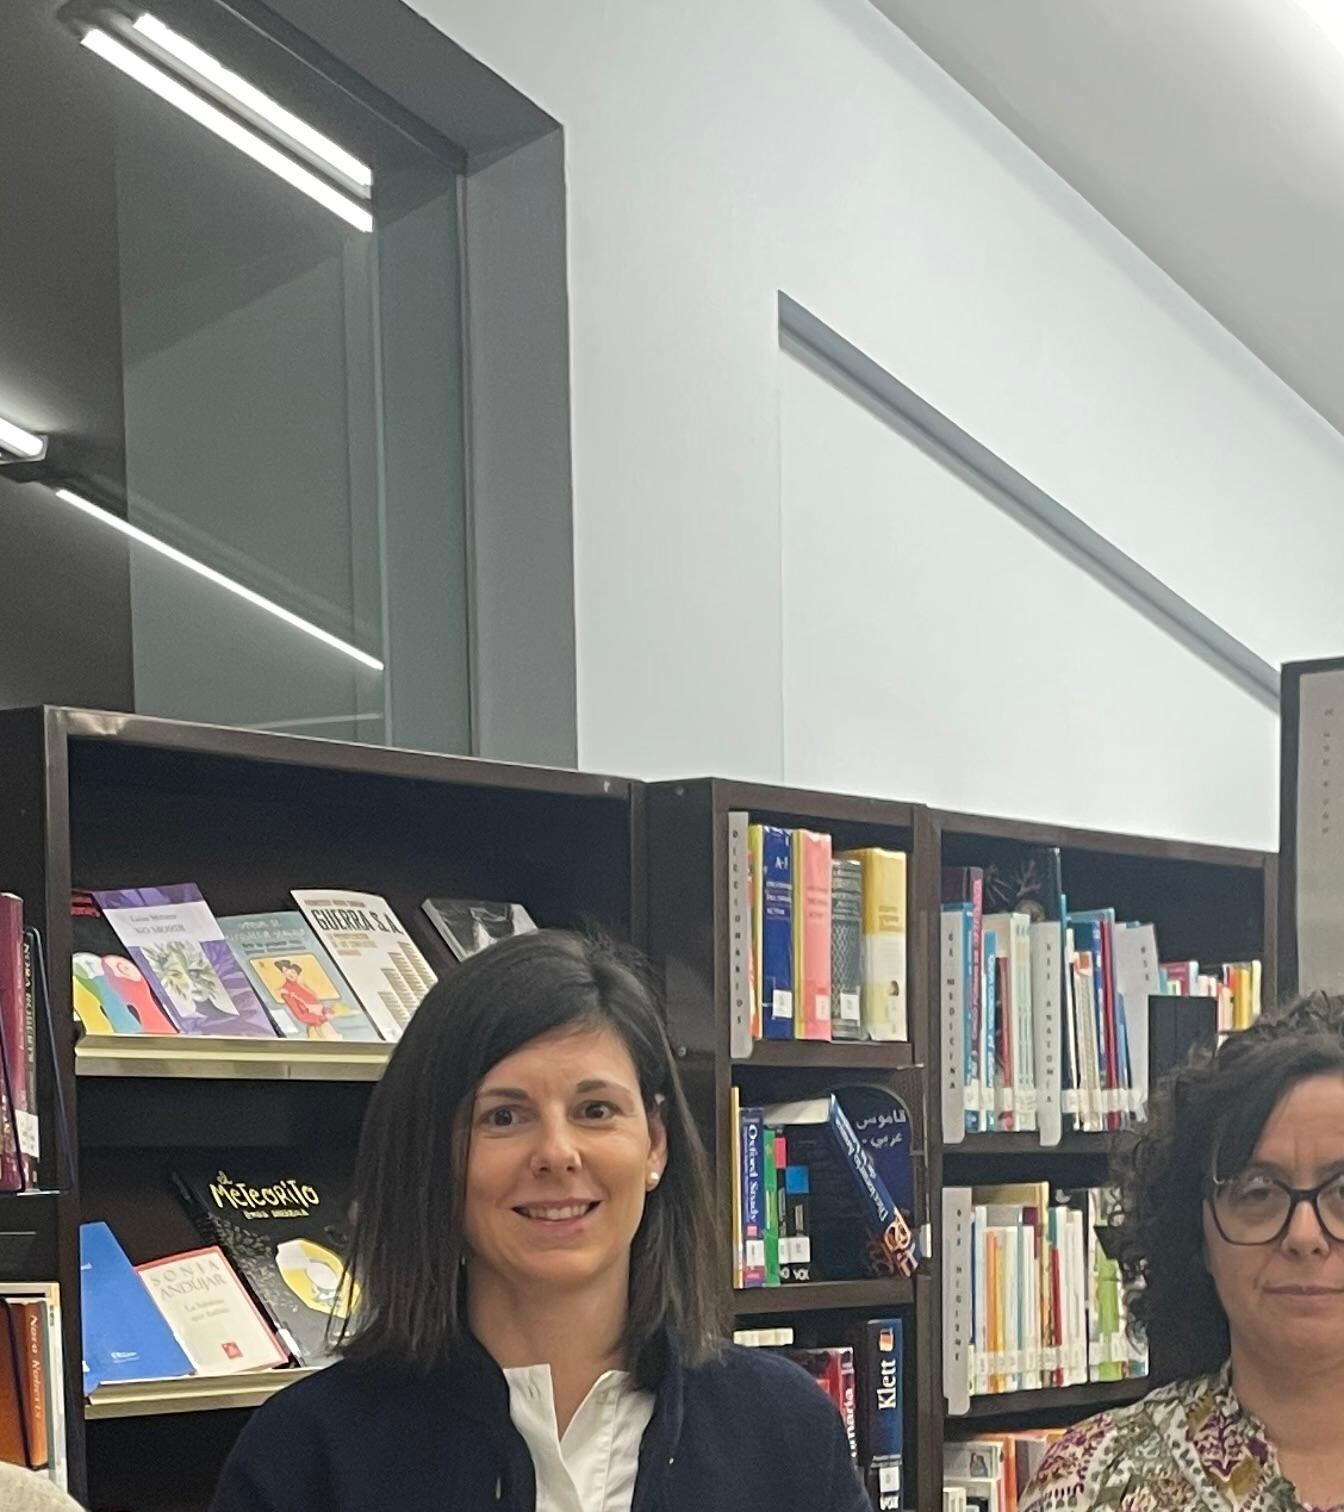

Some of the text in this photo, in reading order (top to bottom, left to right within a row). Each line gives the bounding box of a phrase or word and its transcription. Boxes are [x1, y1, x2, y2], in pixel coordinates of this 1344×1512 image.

[312, 910, 373, 932] GUERRA
[856, 1109, 906, 1130] قاموس
[746, 1123, 759, 1222] Oxford Study
[149, 1260, 220, 1286] SONIA
[29, 1315, 39, 1354] Nora
[878, 1358, 897, 1410] Klett
